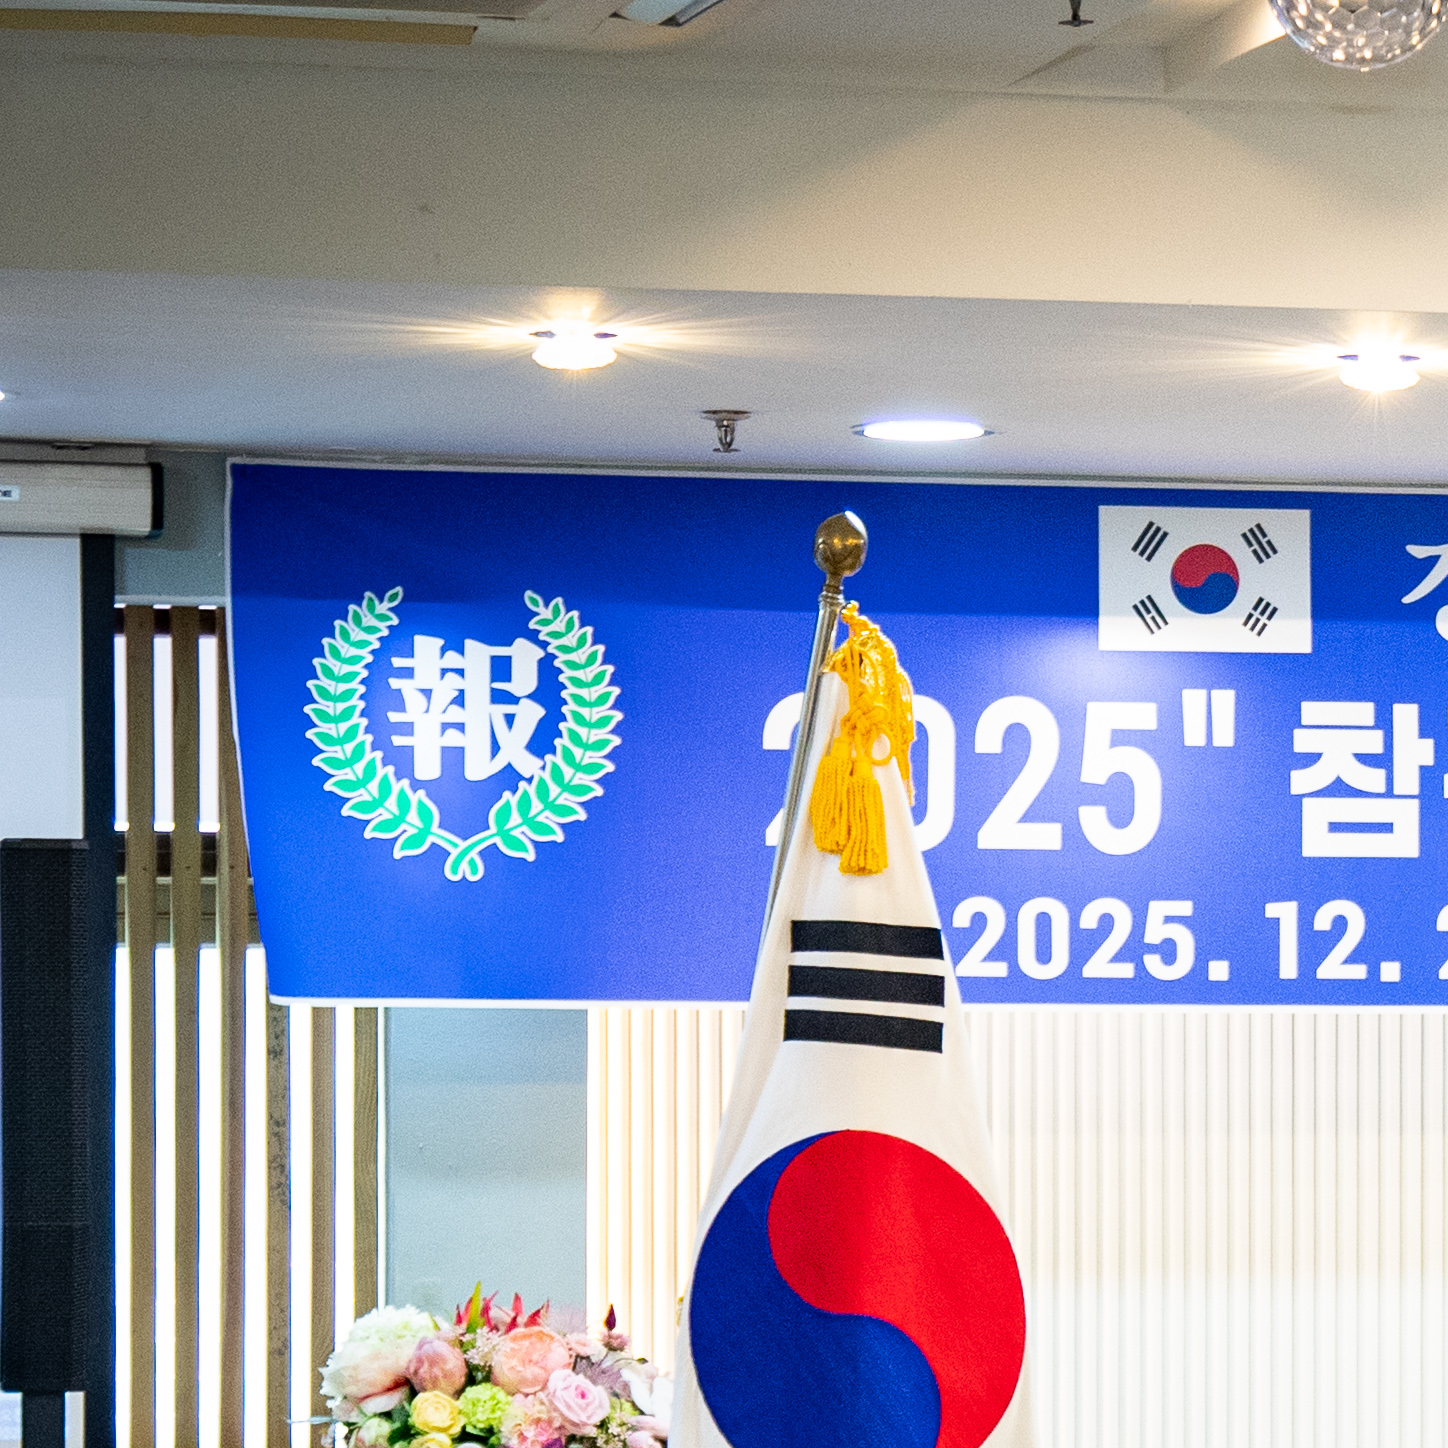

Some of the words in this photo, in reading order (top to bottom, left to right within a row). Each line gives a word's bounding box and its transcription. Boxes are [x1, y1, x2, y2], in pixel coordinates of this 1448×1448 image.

[388, 634, 546, 783] 報
[952, 895, 1230, 982] 2025.
[1263, 898, 1402, 983] 12.
